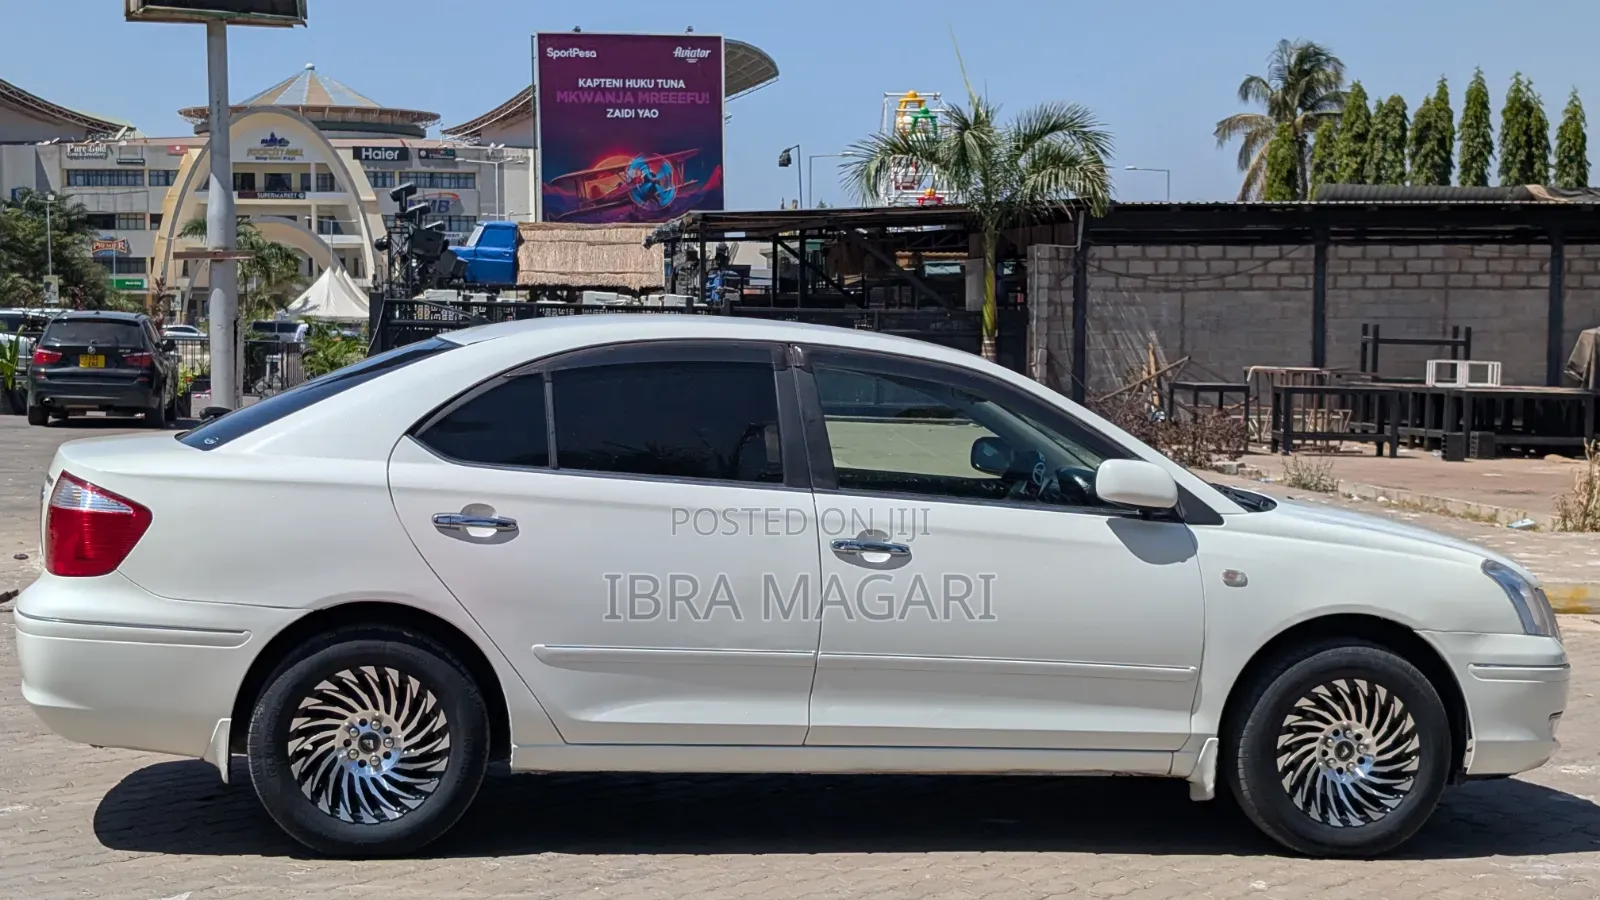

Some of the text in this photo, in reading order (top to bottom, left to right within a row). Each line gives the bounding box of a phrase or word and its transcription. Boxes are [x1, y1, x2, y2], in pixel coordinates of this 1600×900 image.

[546, 48, 597, 60] SportPesa
[673, 46, 711, 58] Aviator
[578, 78, 686, 89] KAPTENI HUKU TUNA
[556, 91, 710, 105] MKWANJA MREEEFU!
[606, 108, 659, 119] ZAIDI YAO
[67, 143, 107, 152] Pure Gold
[361, 147, 400, 160] Haier
